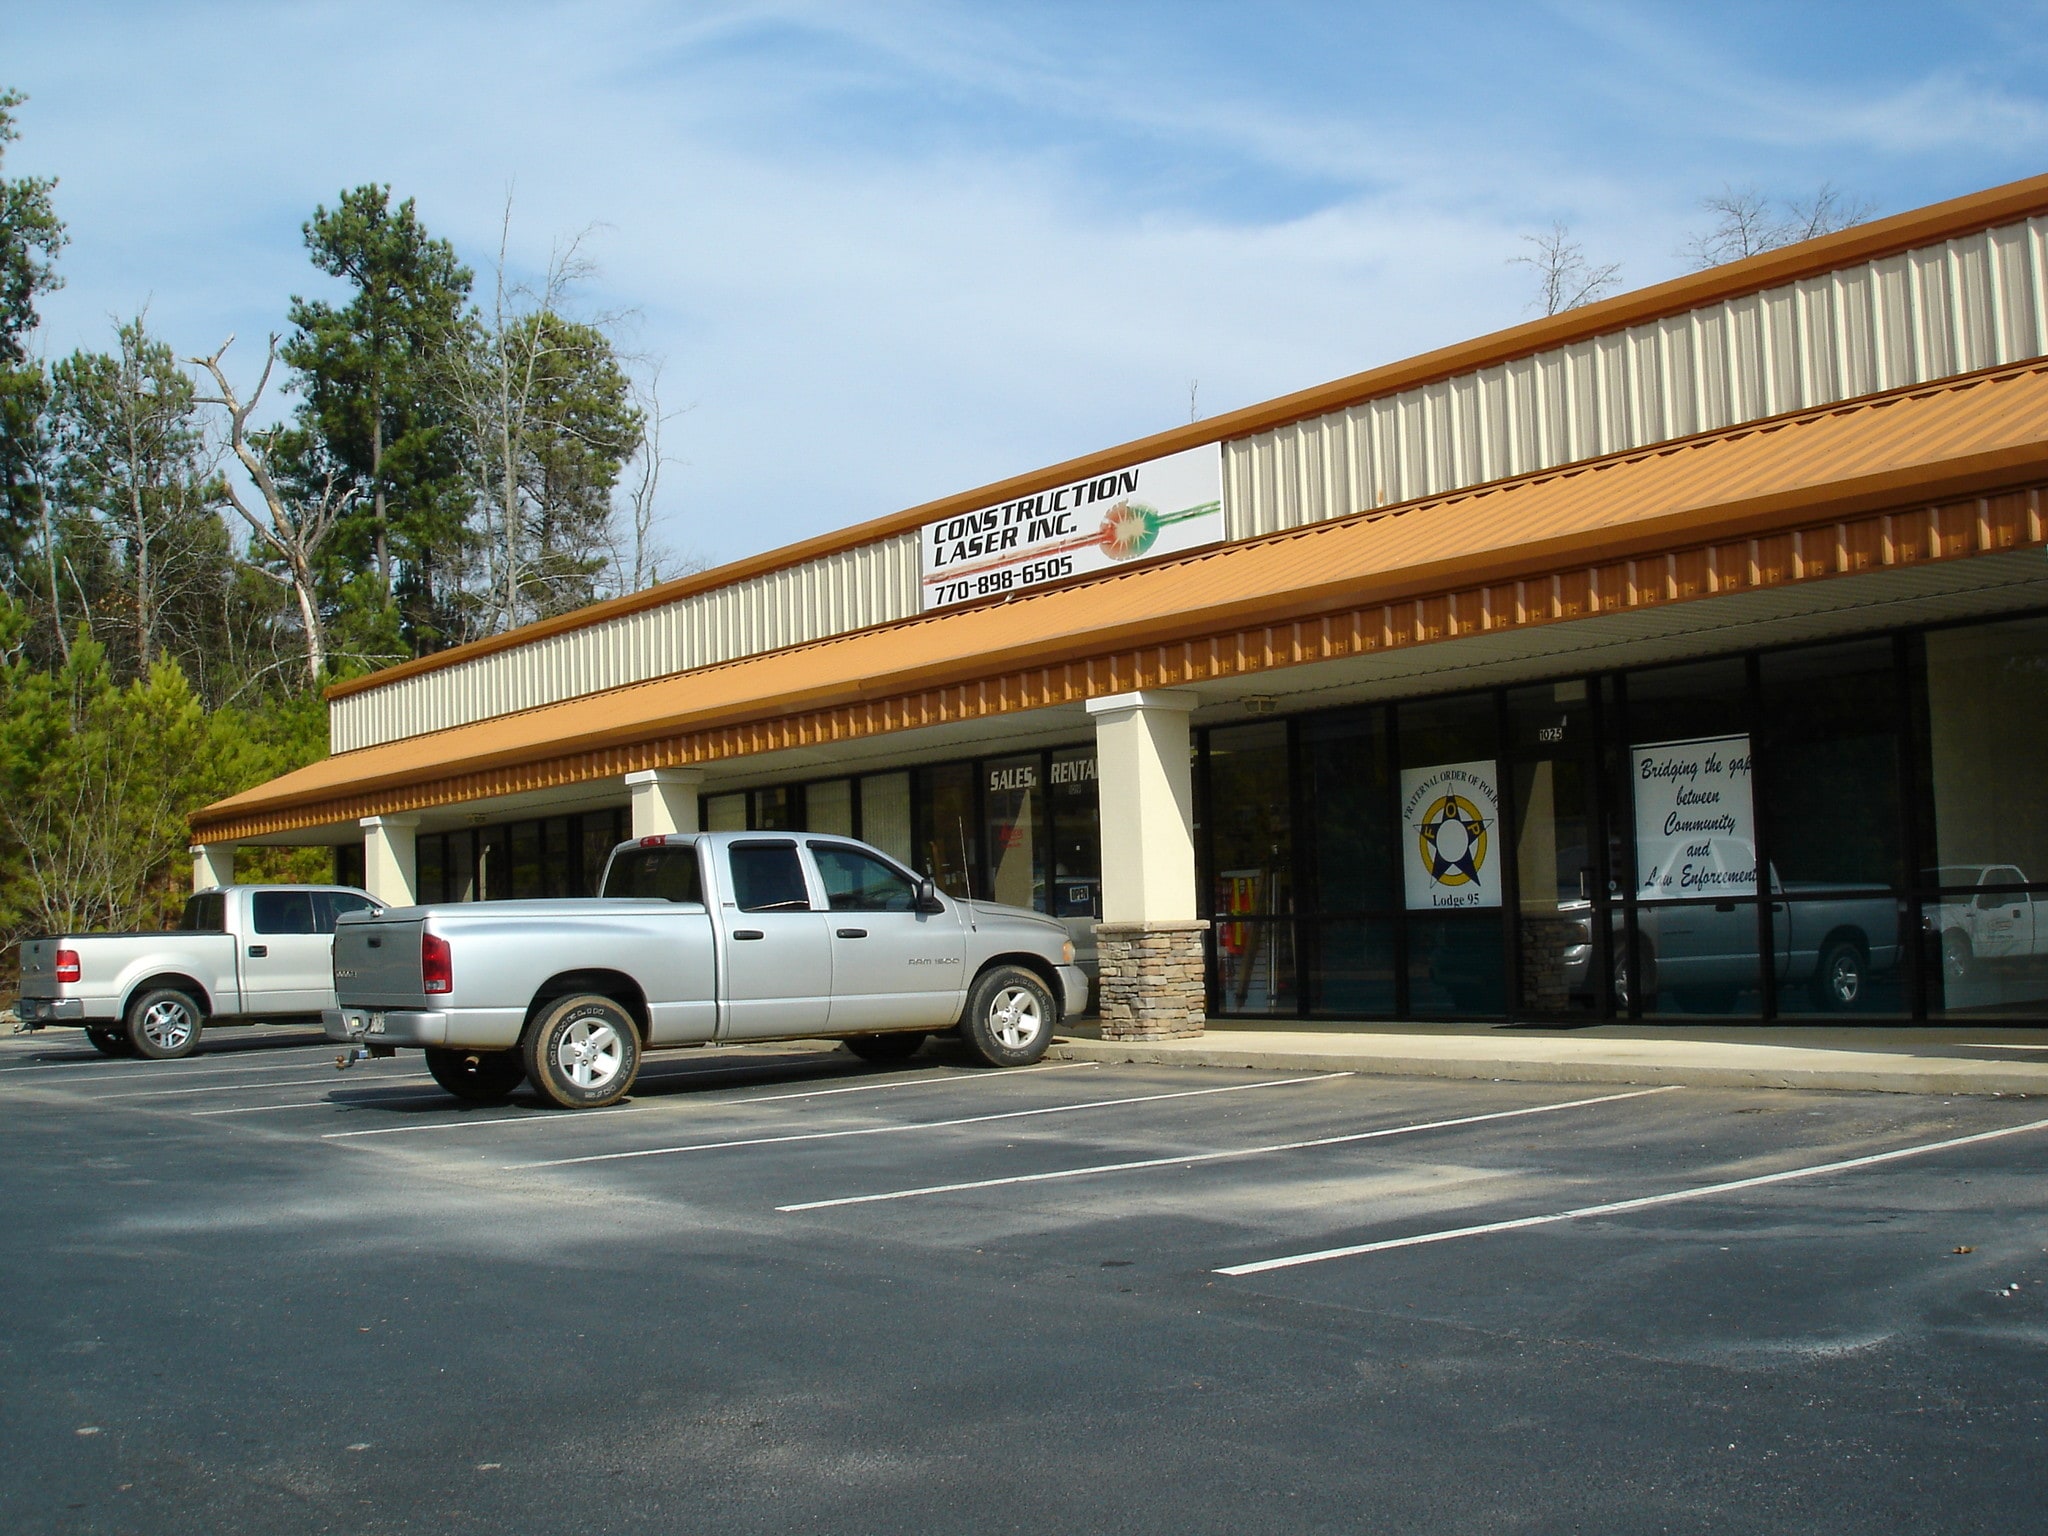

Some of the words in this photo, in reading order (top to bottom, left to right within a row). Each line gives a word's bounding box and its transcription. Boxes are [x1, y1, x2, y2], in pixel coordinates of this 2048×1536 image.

[934, 469, 1139, 544] CONSTRUCTION
[934, 522, 1019, 567] LASER
[1028, 512, 1078, 543] INC.
[935, 556, 1073, 605] 770-898-6505
[1540, 728, 1562, 740] 1025
[1641, 757, 1698, 783] Bridging
[1705, 752, 1723, 773] the
[1729, 754, 1752, 779] gap
[1404, 775, 1438, 820] FRATERNAL
[1440, 770, 1467, 782] ORDER
[1468, 774, 1480, 786] OF
[1676, 785, 1720, 806] between
[1664, 811, 1736, 836] Community
[1686, 838, 1711, 857] and
[1681, 863, 1757, 891] Enforcement
[1433, 894, 1465, 907] Lodge
[1467, 893, 1480, 905] 95
